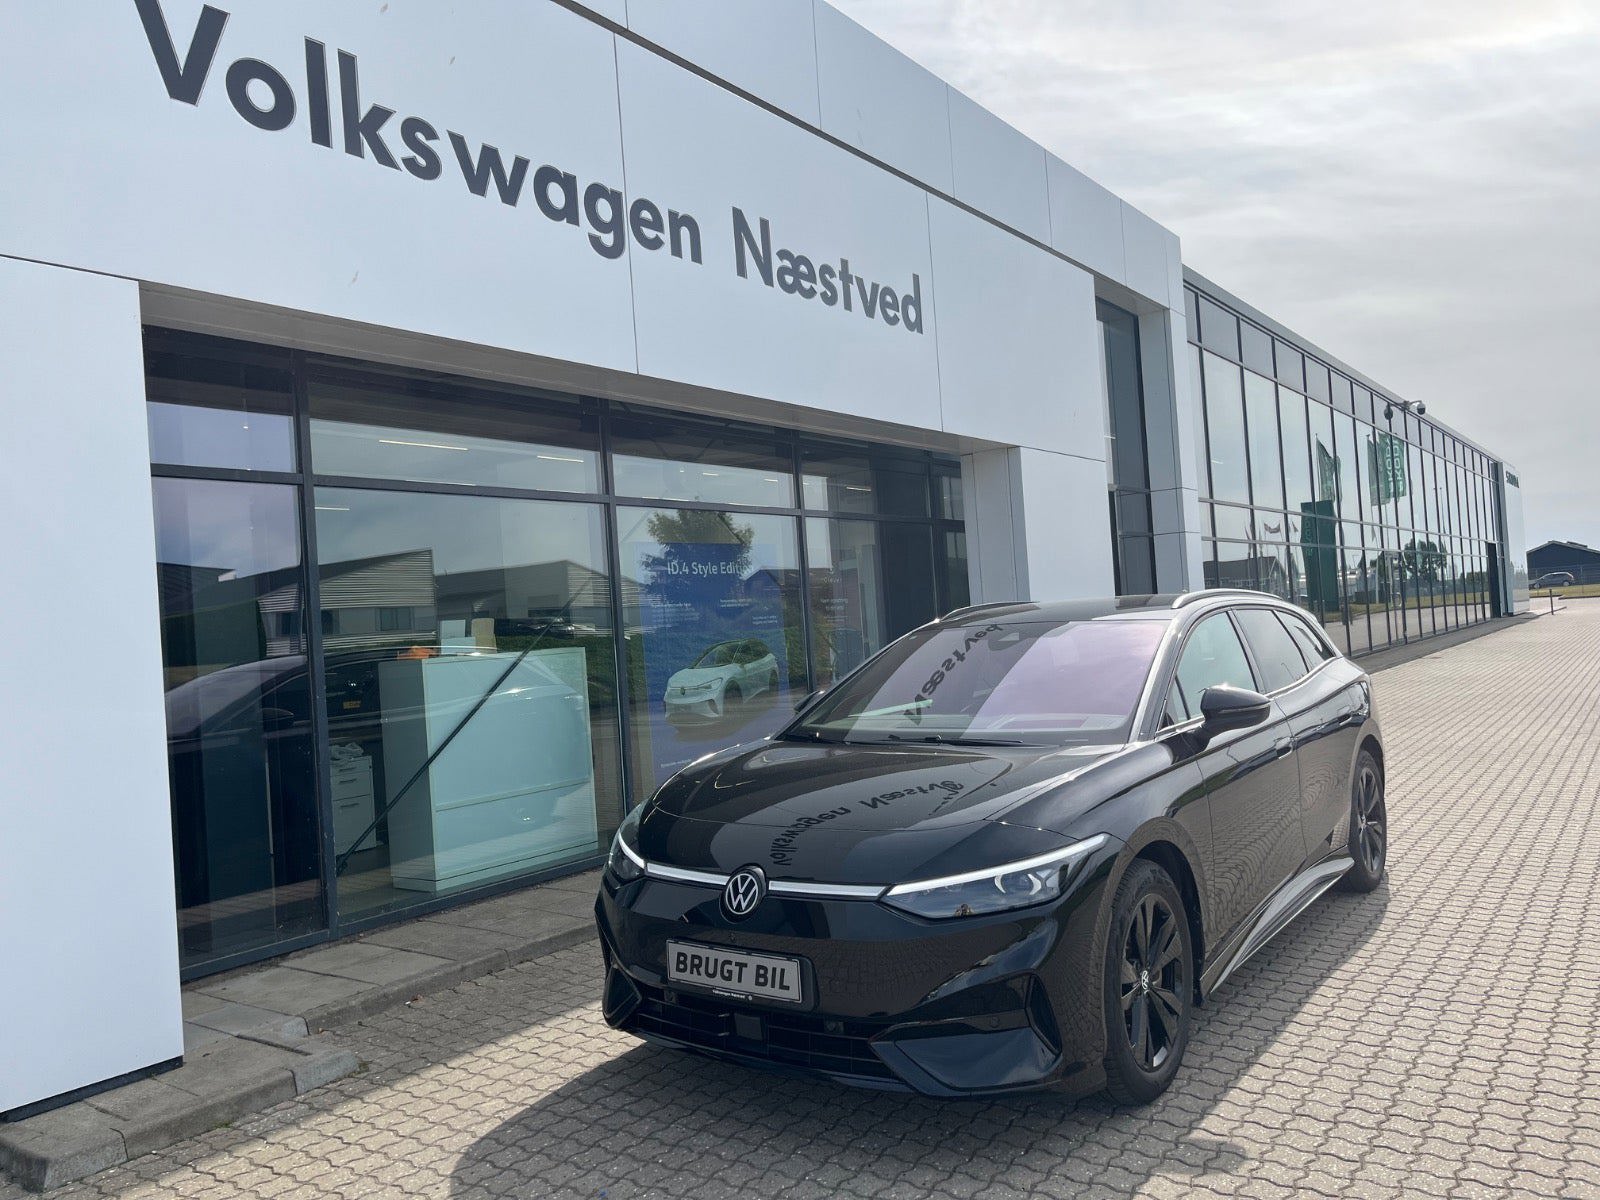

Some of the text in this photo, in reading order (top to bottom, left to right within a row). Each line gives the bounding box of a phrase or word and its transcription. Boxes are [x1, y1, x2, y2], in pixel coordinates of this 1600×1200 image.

[133, 0, 924, 335] Volkswagen Næstved
[667, 561, 689, 575] ID.4
[691, 561, 718, 578] Style
[675, 951, 791, 991] BRUGT BIL
